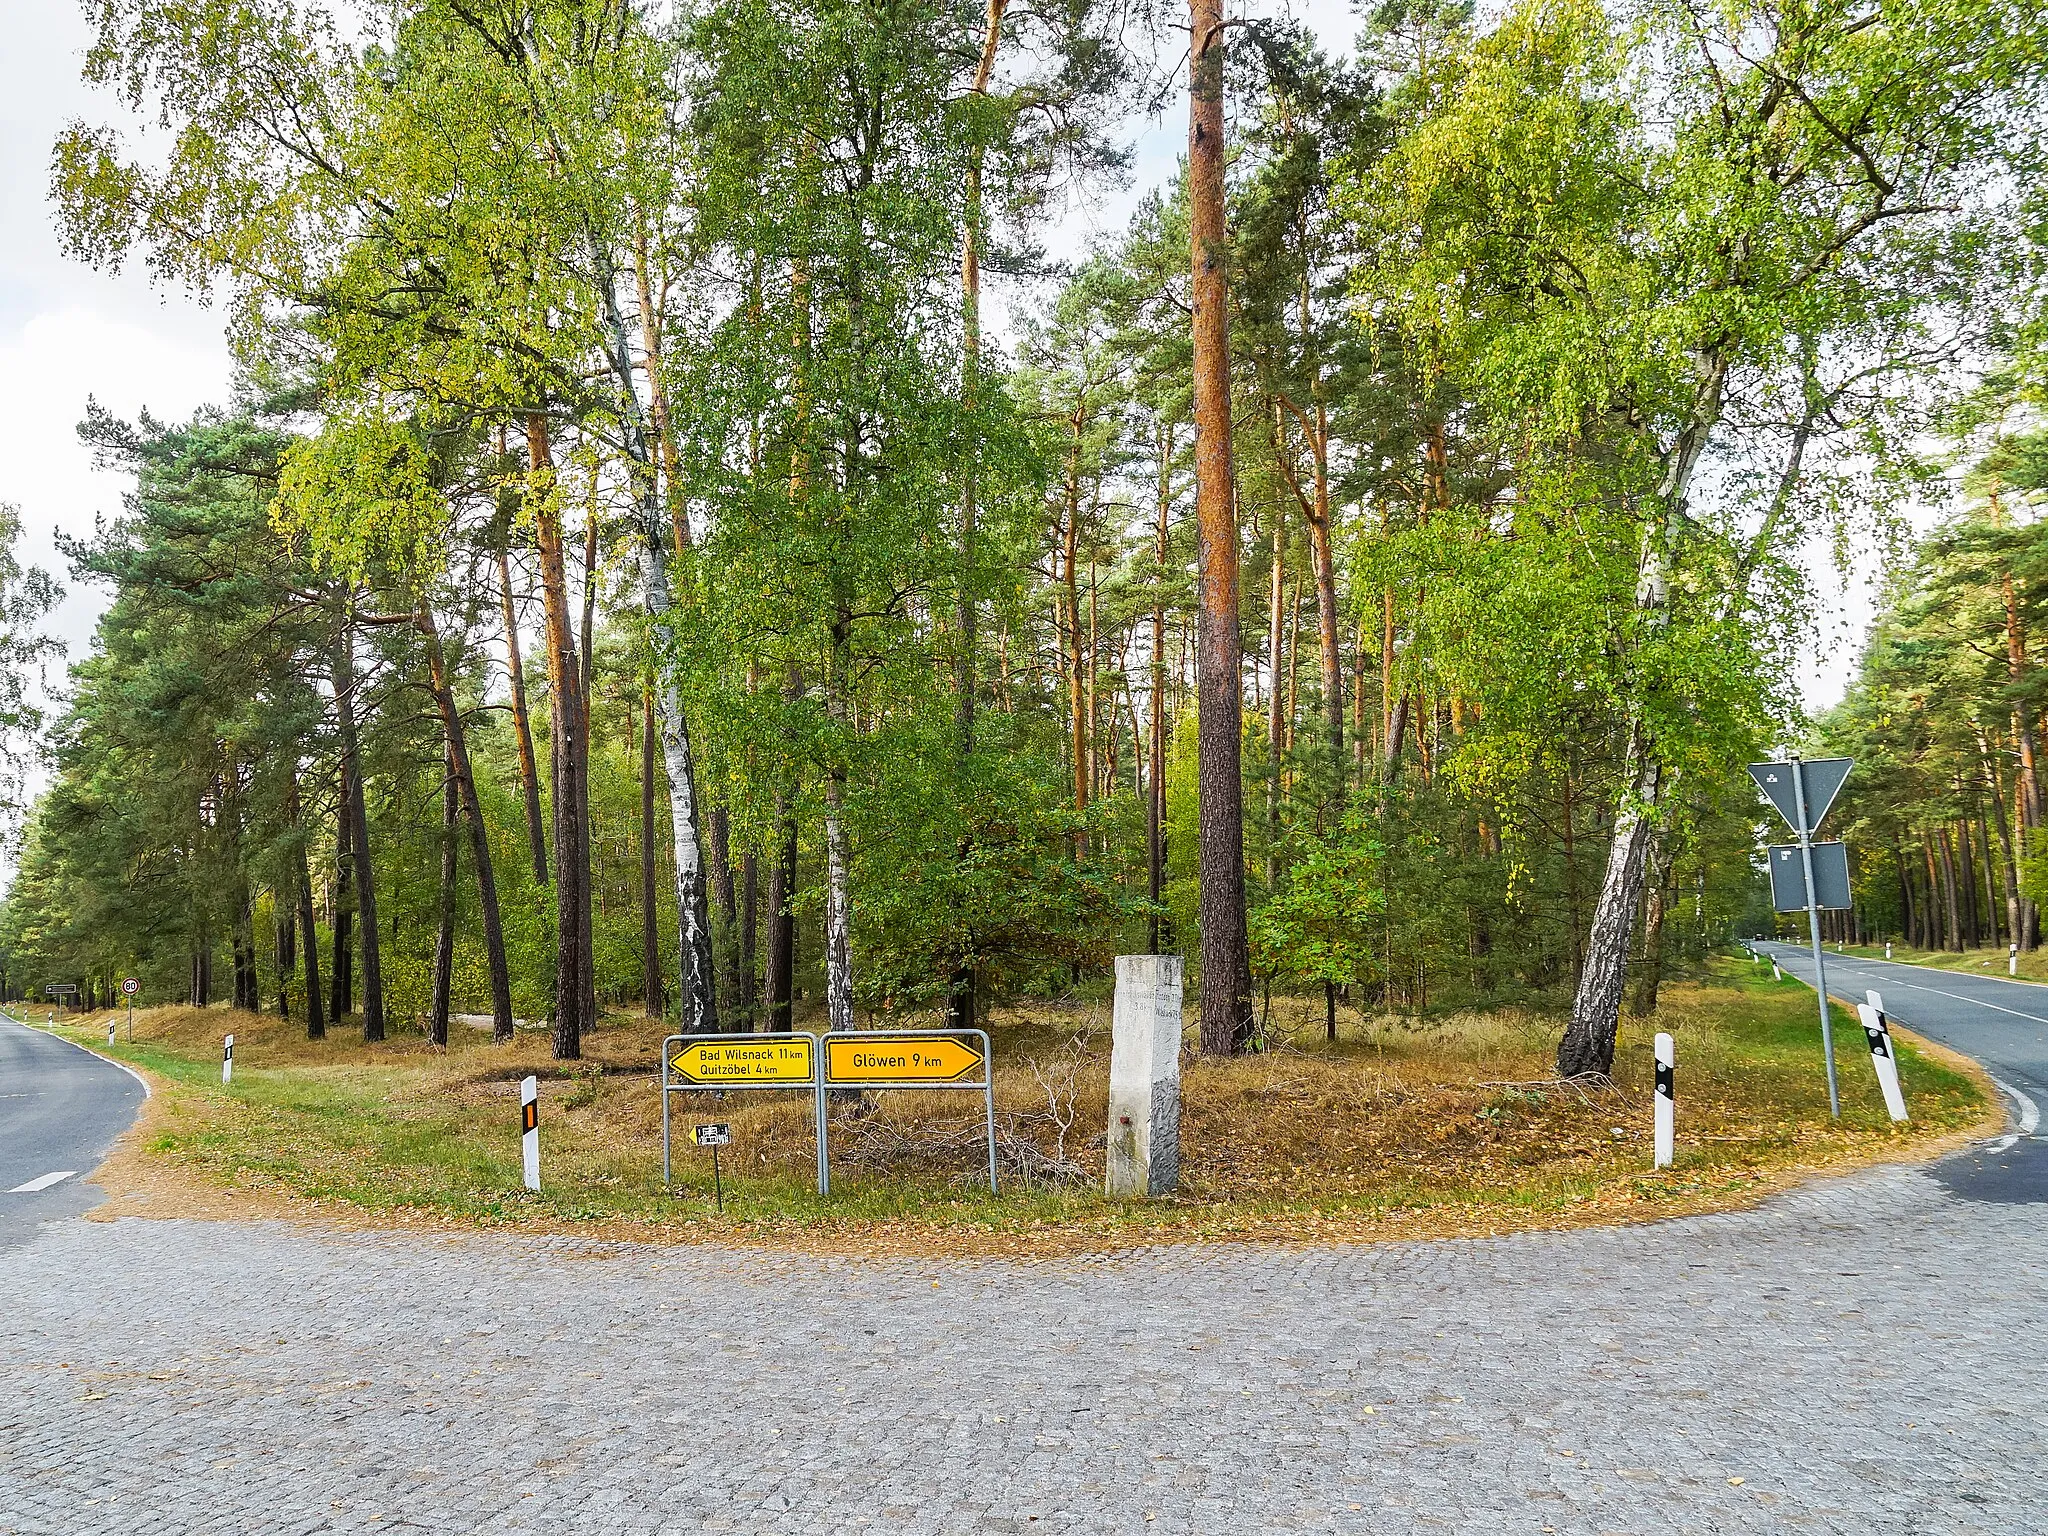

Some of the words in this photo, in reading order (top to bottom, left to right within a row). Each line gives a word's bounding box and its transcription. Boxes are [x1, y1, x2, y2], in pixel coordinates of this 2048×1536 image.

[700, 1050, 720, 1060] Bad
[725, 1049, 774, 1060] Wilsnack
[779, 1048, 788, 1059] 11
[789, 1051, 803, 1059] km
[853, 1053, 906, 1067] Glöwen
[912, 1053, 921, 1067] 9
[924, 1056, 942, 1067] km
[700, 1063, 751, 1075] Quitzöbel
[755, 1063, 763, 1074] 4
[765, 1066, 778, 1074] km
